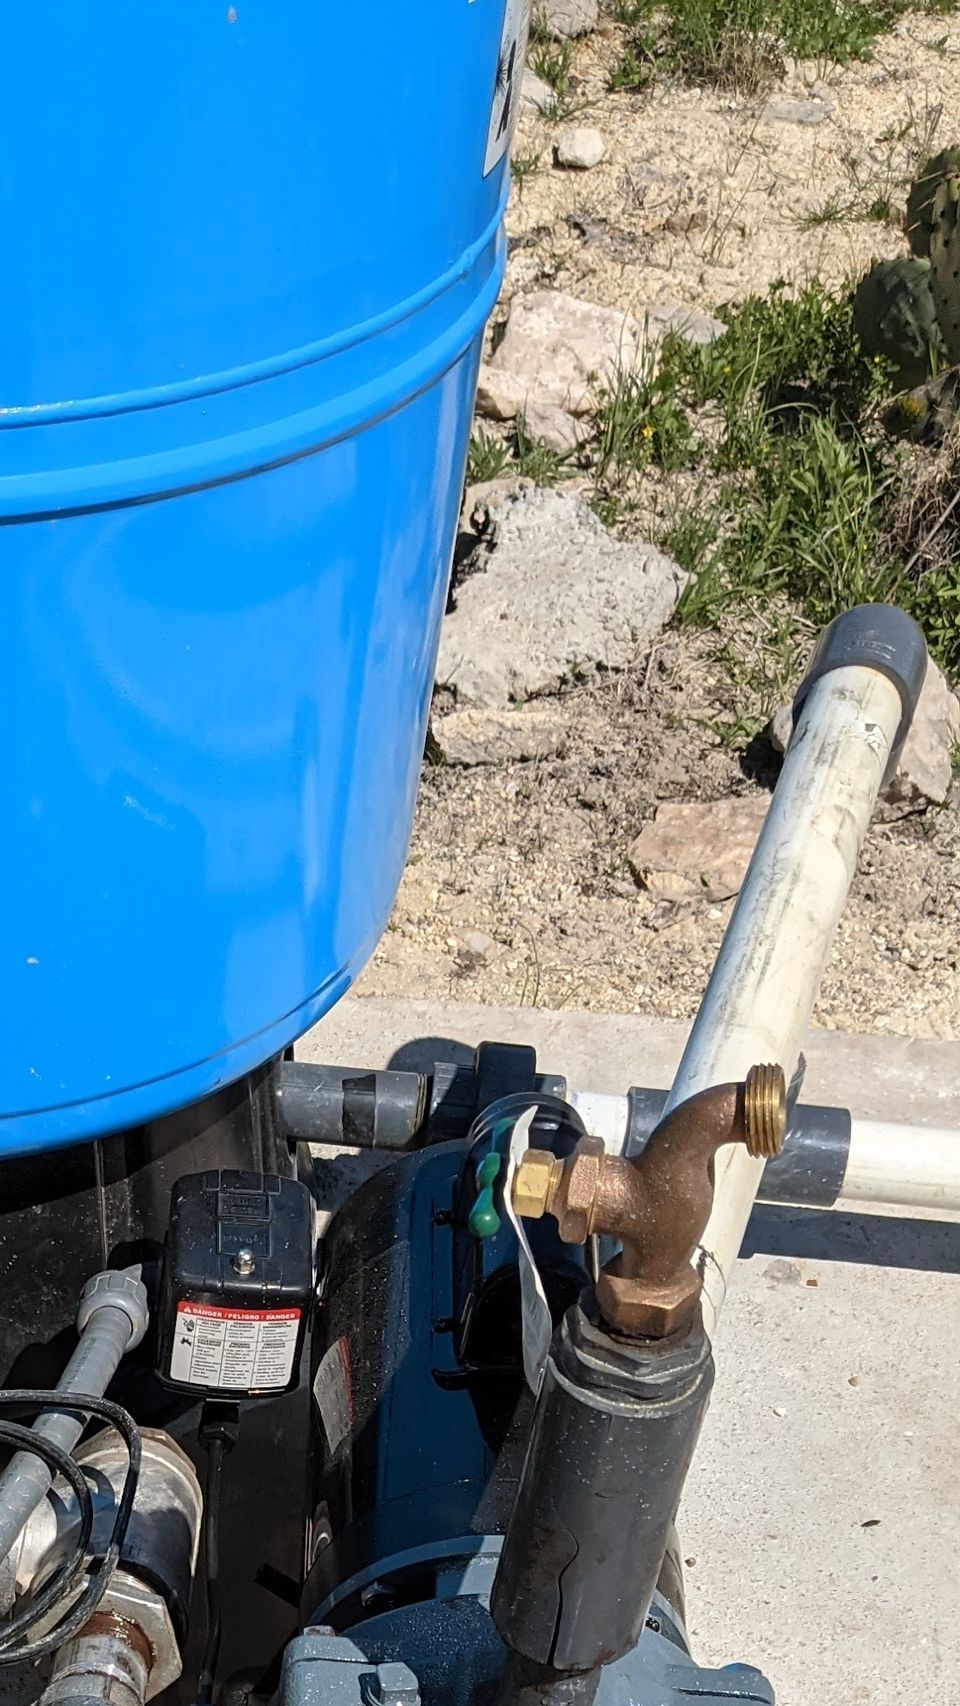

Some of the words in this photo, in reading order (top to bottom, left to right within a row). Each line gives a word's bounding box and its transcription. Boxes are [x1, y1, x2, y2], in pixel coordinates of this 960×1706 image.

[192, 1308, 224, 1319] DANGER
[227, 1312, 260, 1321] PELIGRO
[266, 1313, 296, 1321] DANGER
